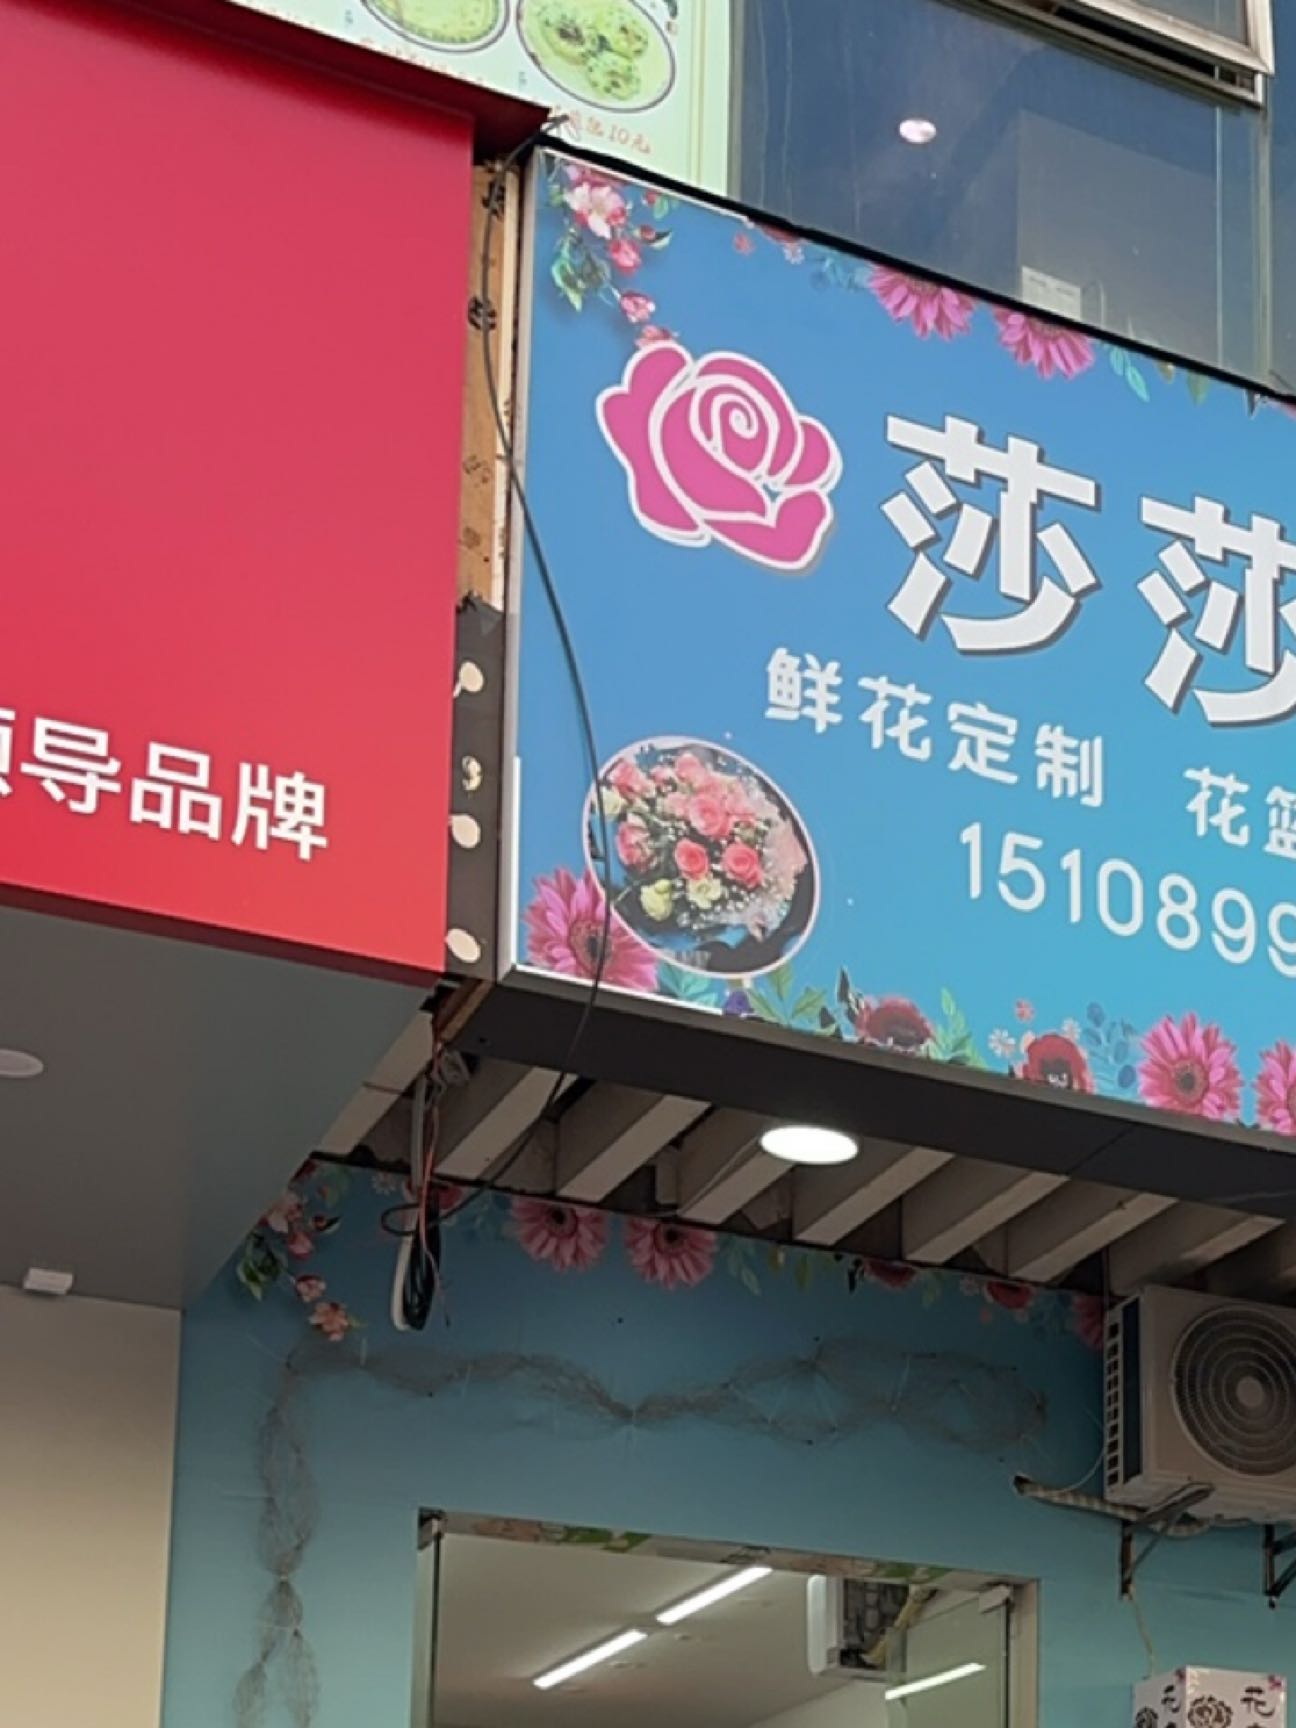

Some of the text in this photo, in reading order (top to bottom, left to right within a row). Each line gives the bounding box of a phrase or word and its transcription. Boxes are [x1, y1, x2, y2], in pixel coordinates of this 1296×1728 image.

[0, 706, 329, 862] 导品牌
[764, 646, 1105, 808] 鲜花定制
